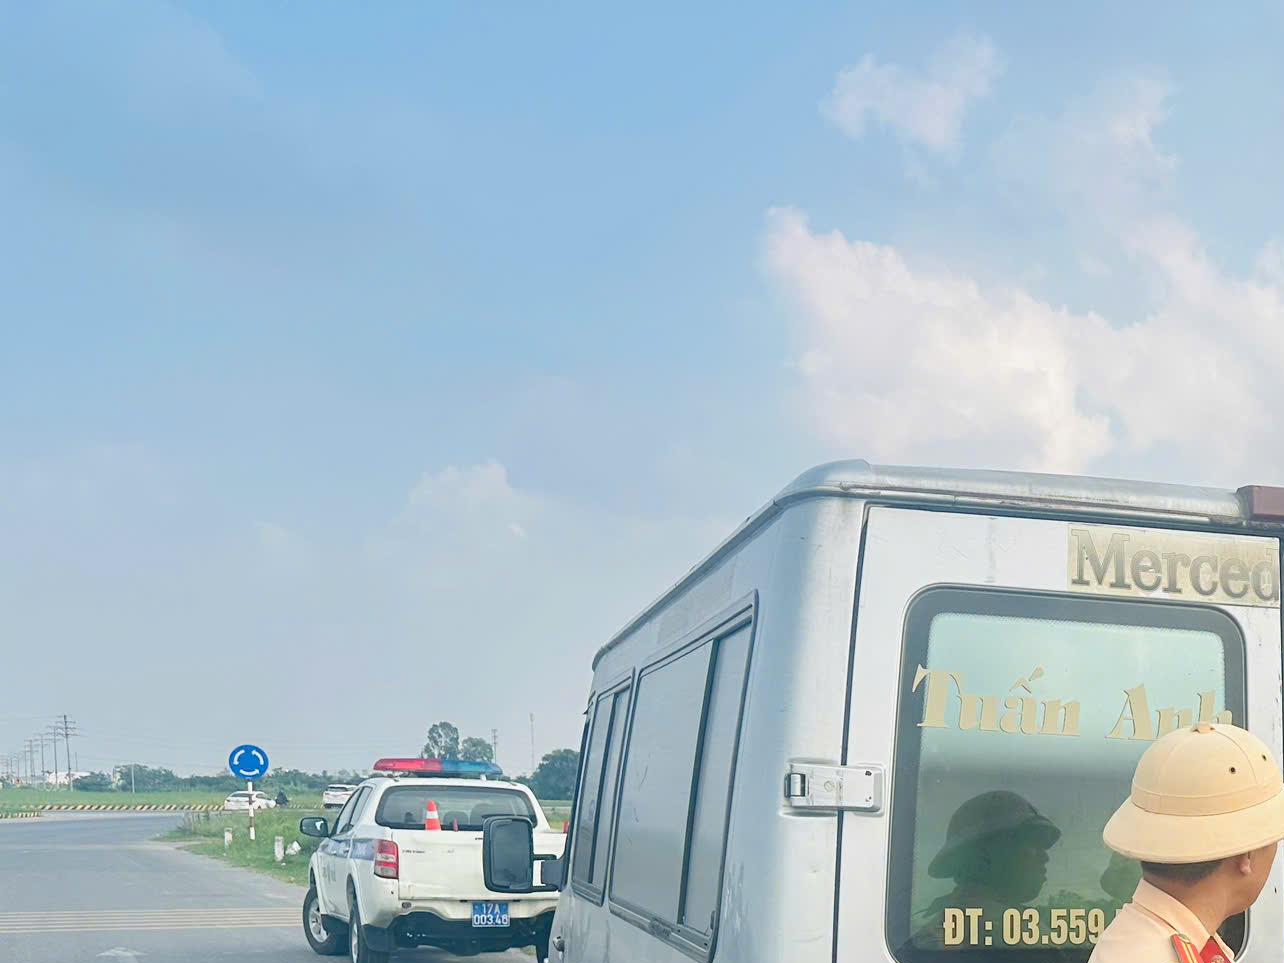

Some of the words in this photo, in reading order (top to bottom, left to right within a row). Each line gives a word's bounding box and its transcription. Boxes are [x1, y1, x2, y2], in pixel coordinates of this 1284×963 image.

[912, 664, 1080, 736] Tuấn
[1104, 684, 1232, 741] Anh
[943, 908, 992, 945] ĐT:
[1003, 908, 1122, 945] 03.559
